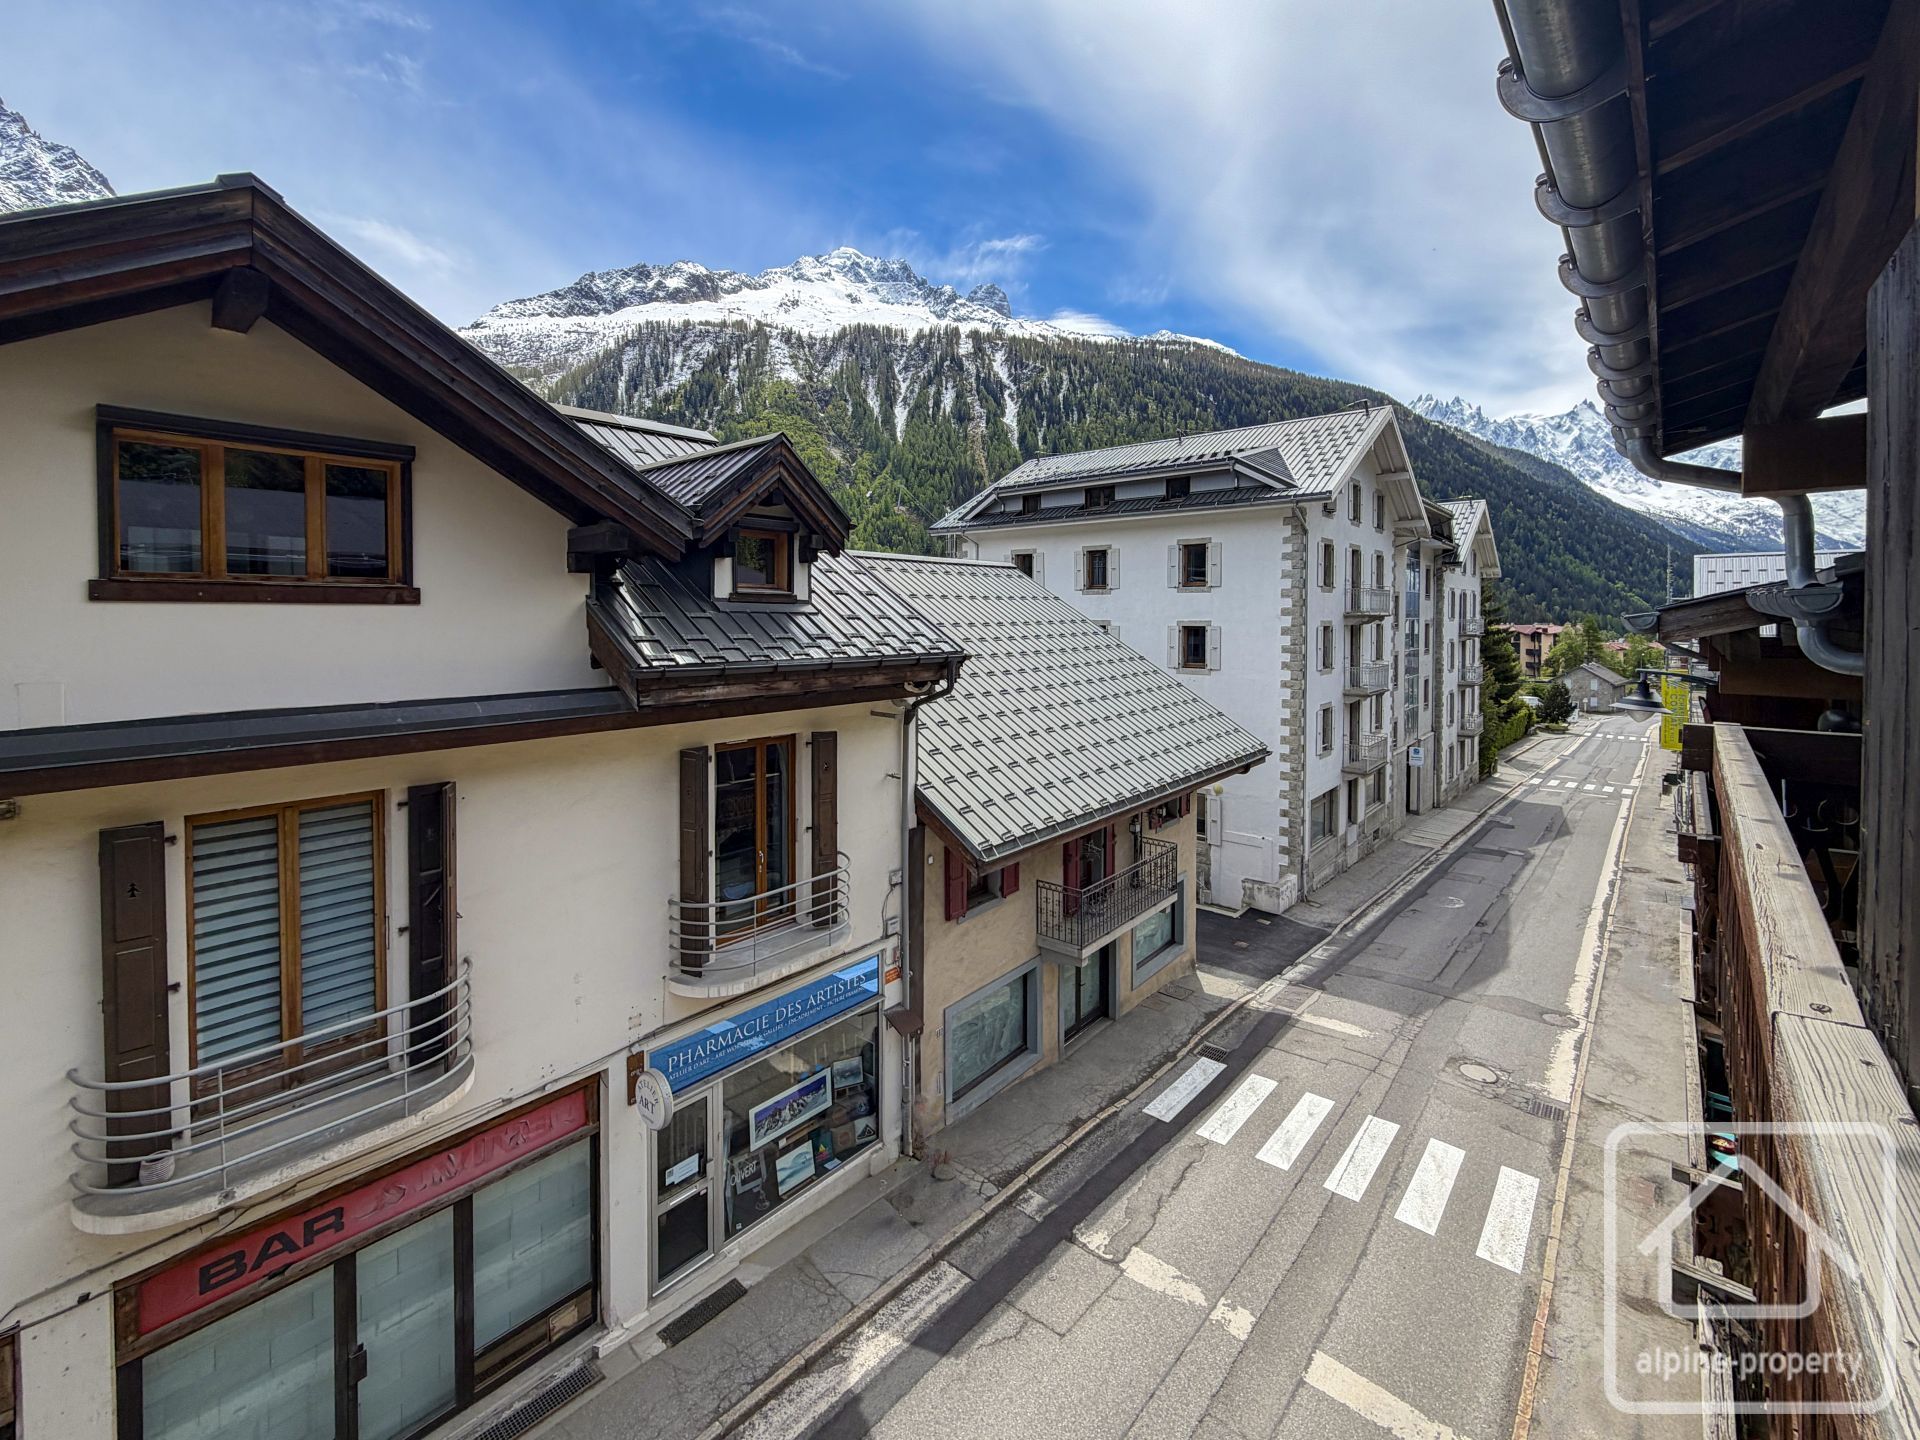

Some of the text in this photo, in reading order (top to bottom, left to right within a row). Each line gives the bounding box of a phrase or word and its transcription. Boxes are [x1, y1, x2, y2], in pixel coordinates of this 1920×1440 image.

[668, 974, 866, 1073] PHARMACIE DES ARTISTES
[669, 1064, 693, 1080] ATELIER
[639, 1095, 655, 1114] ART
[730, 1160, 758, 1186] OUVERT
[199, 1206, 345, 1296] BAR
